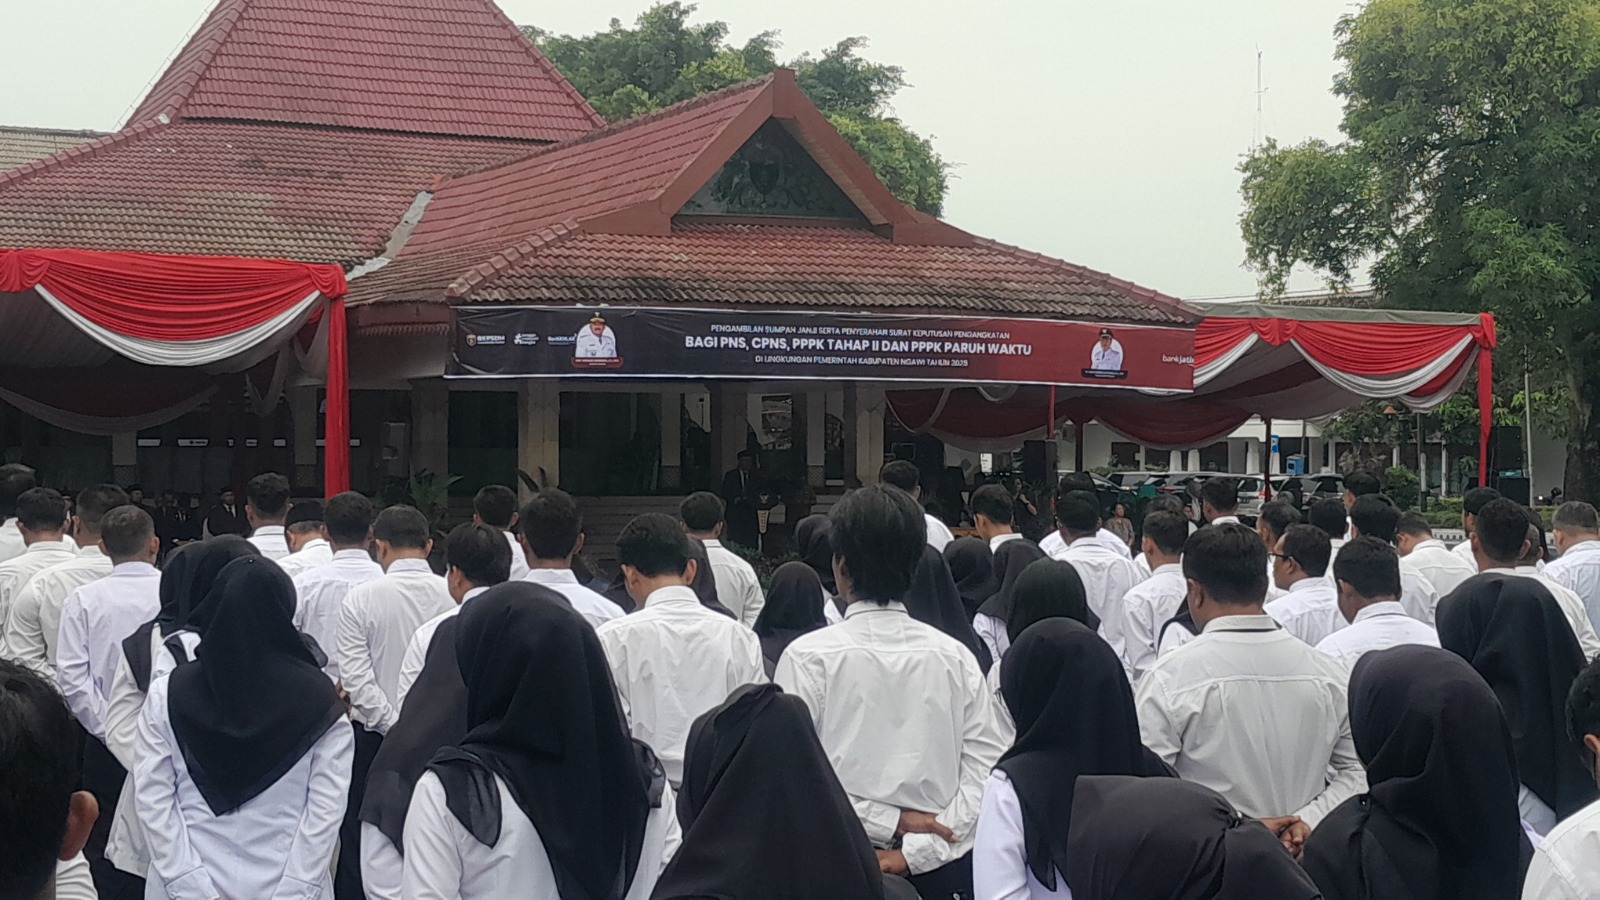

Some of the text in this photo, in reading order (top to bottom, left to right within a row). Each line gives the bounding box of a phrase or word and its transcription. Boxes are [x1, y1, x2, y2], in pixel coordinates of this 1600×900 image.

[711, 324, 1010, 339] PENGAMBILAN SUMPAH JANJI SERTA PENYERAHAN SURAT KEPUTUSAN PENGANGKATAN
[685, 335, 1032, 356] BAGI PNS, CPNS, PPPK TAHAP II DAN PPPK PARUH WAKTU
[755, 355, 764, 363] DI
[764, 355, 813, 364] LINGKUNGAN
[813, 356, 858, 365] PEMERINTAH
[858, 357, 900, 366] KABUPATEN
[900, 358, 926, 366] NGAWI
[927, 358, 950, 367] TAHUN
